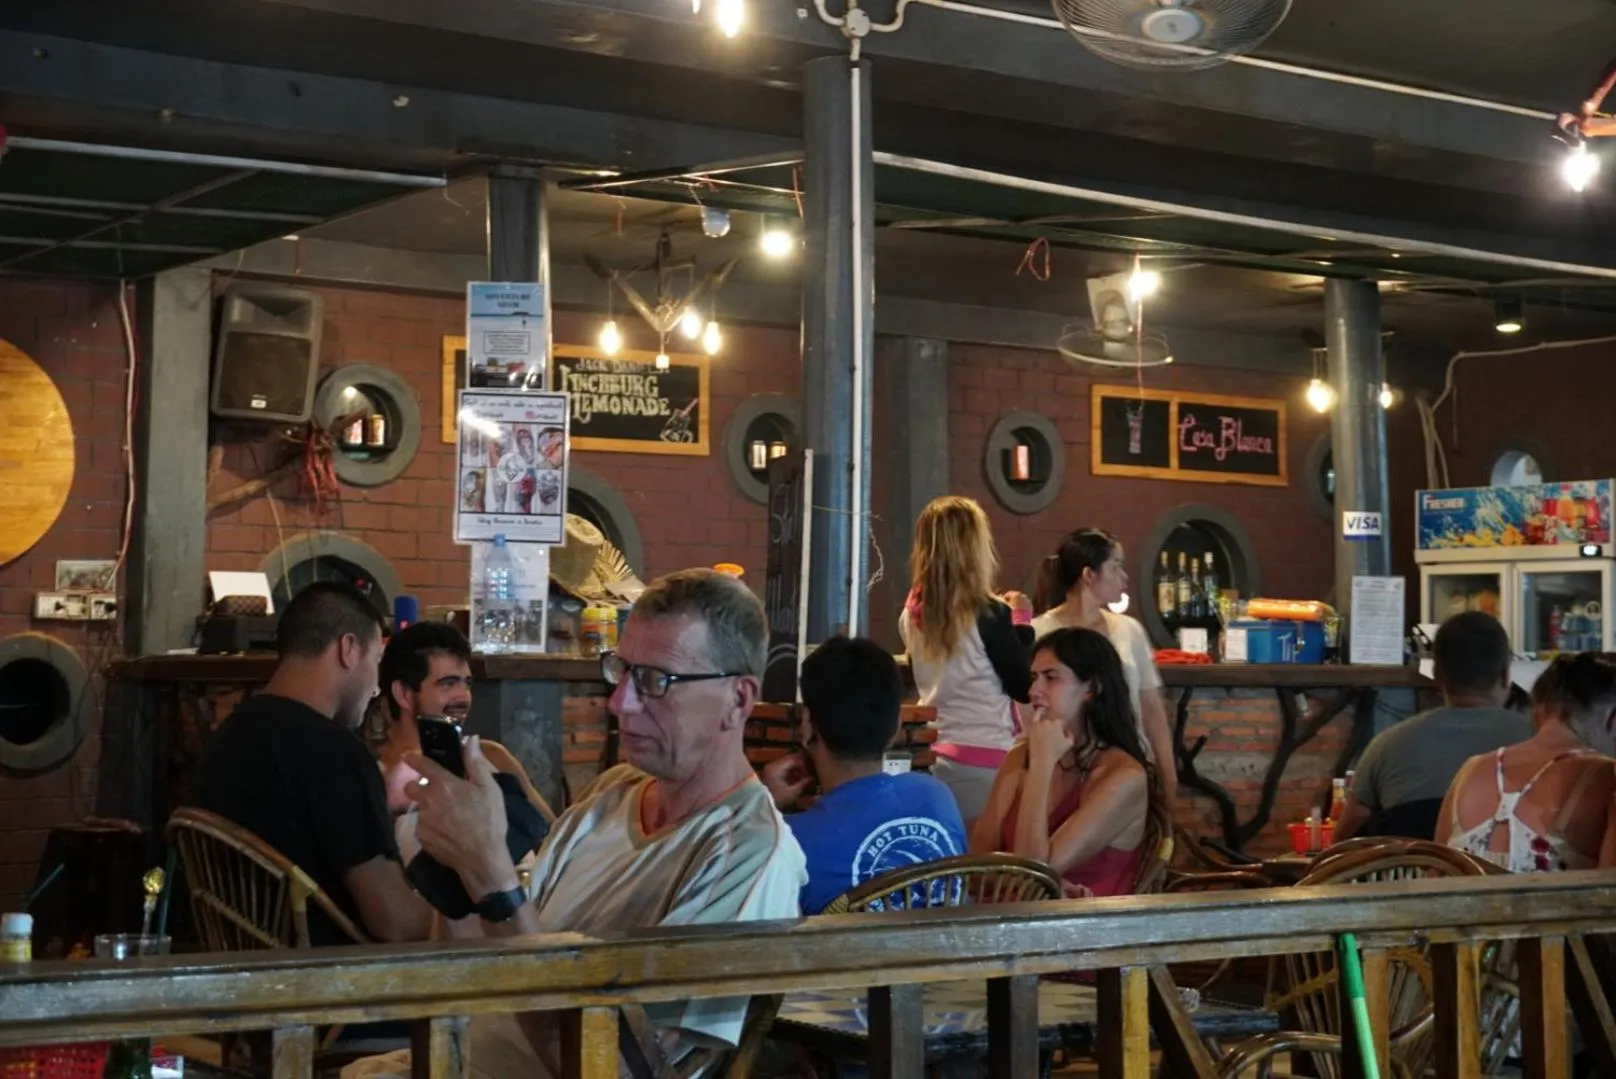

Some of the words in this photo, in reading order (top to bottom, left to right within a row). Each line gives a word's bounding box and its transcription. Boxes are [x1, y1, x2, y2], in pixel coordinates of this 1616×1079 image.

[575, 357, 608, 372] JACK
[572, 392, 671, 424] LEMONADE
[1347, 516, 1380, 530] VISA
[867, 831, 893, 857] HOT
[897, 824, 938, 842] TUNA
